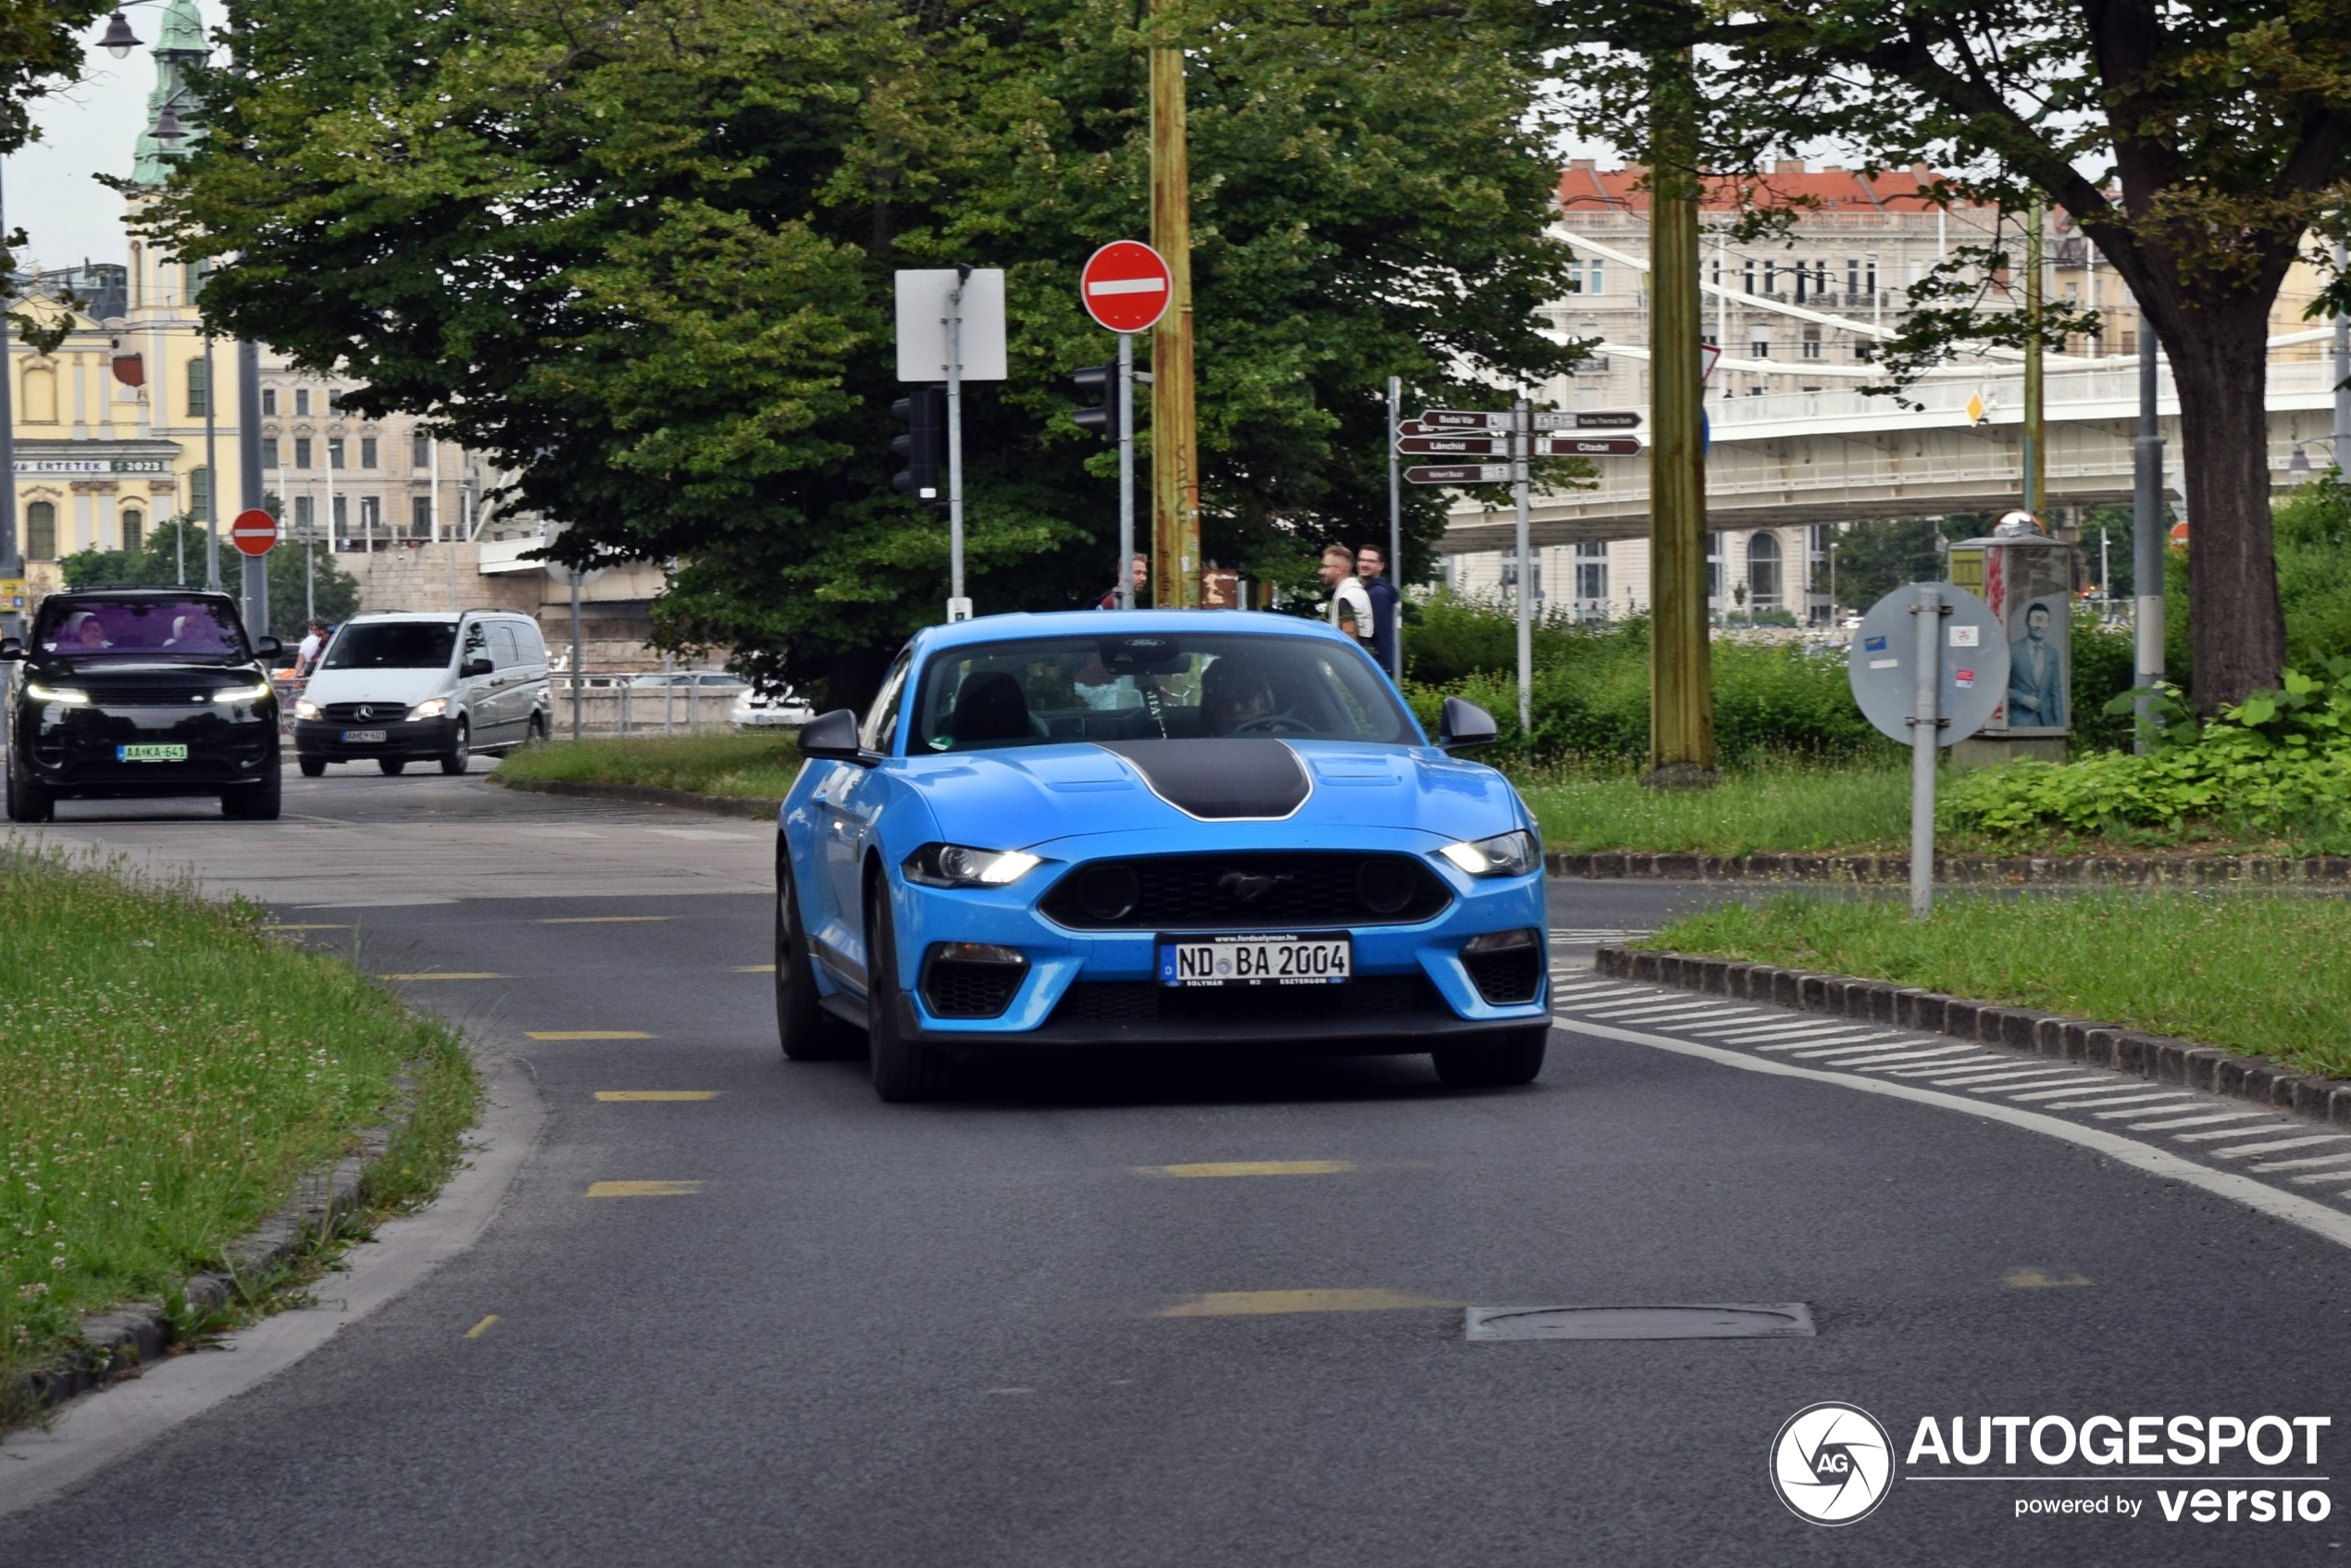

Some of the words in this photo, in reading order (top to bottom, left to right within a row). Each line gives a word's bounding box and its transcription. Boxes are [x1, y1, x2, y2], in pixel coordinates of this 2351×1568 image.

[126, 462, 160, 471] 2023
[1214, 934, 1298, 942] www.fordsolymar.hu
[1178, 947, 1213, 977] ND
[1236, 946, 1270, 976] BA
[1278, 944, 1345, 975] 2004
